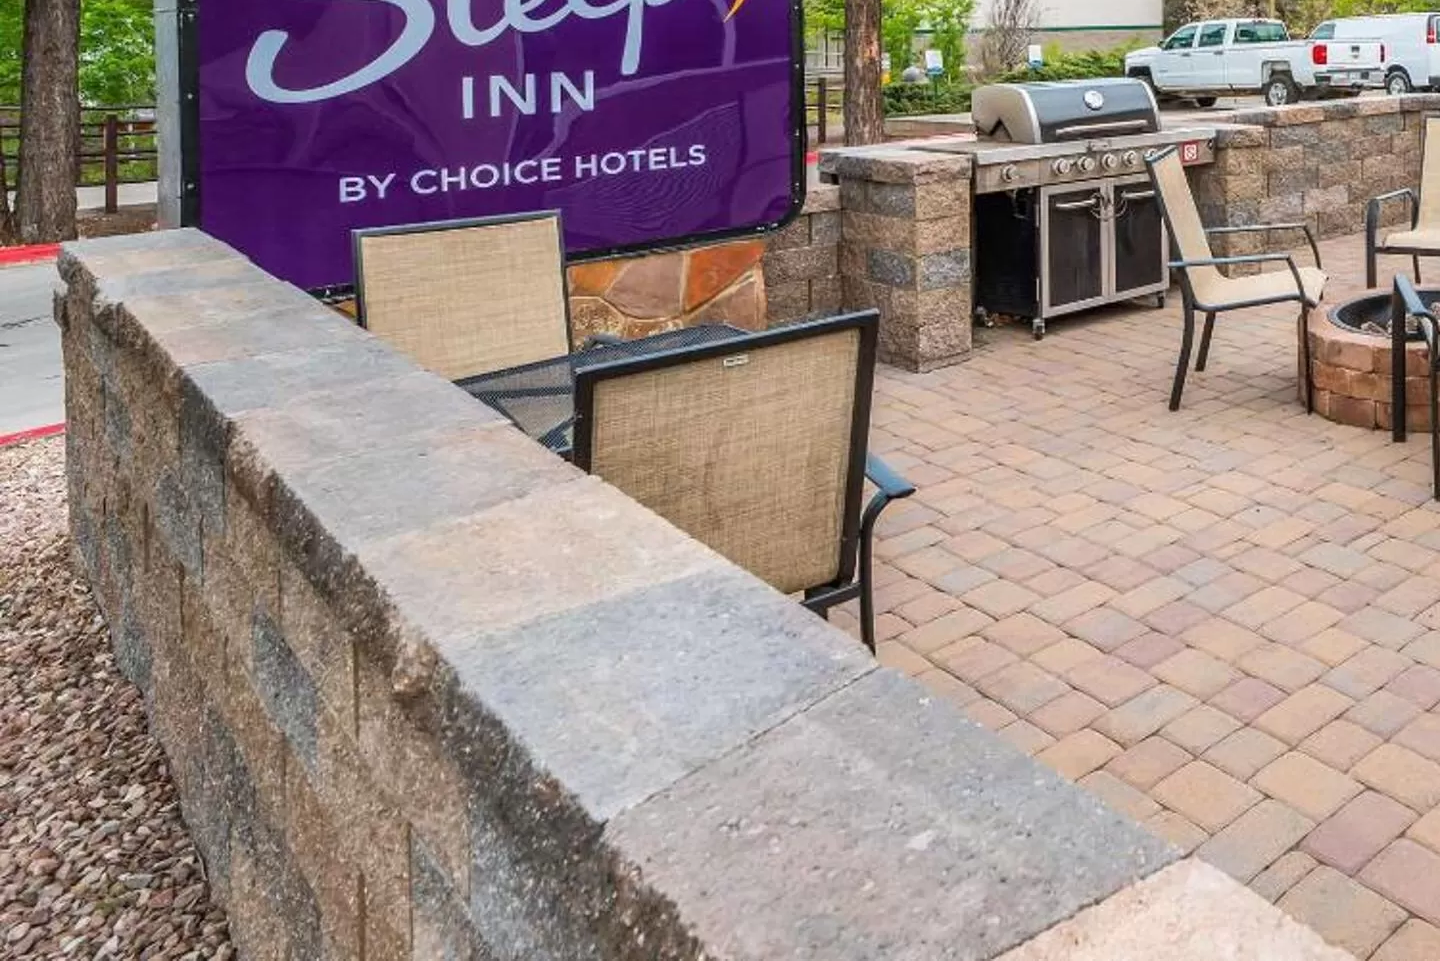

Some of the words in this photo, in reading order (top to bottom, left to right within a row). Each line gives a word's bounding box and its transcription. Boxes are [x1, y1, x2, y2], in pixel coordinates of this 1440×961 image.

[462, 70, 595, 119] INN
[339, 173, 396, 203] BY
[410, 157, 562, 195] CHOICE
[575, 144, 706, 179] HOTELS
